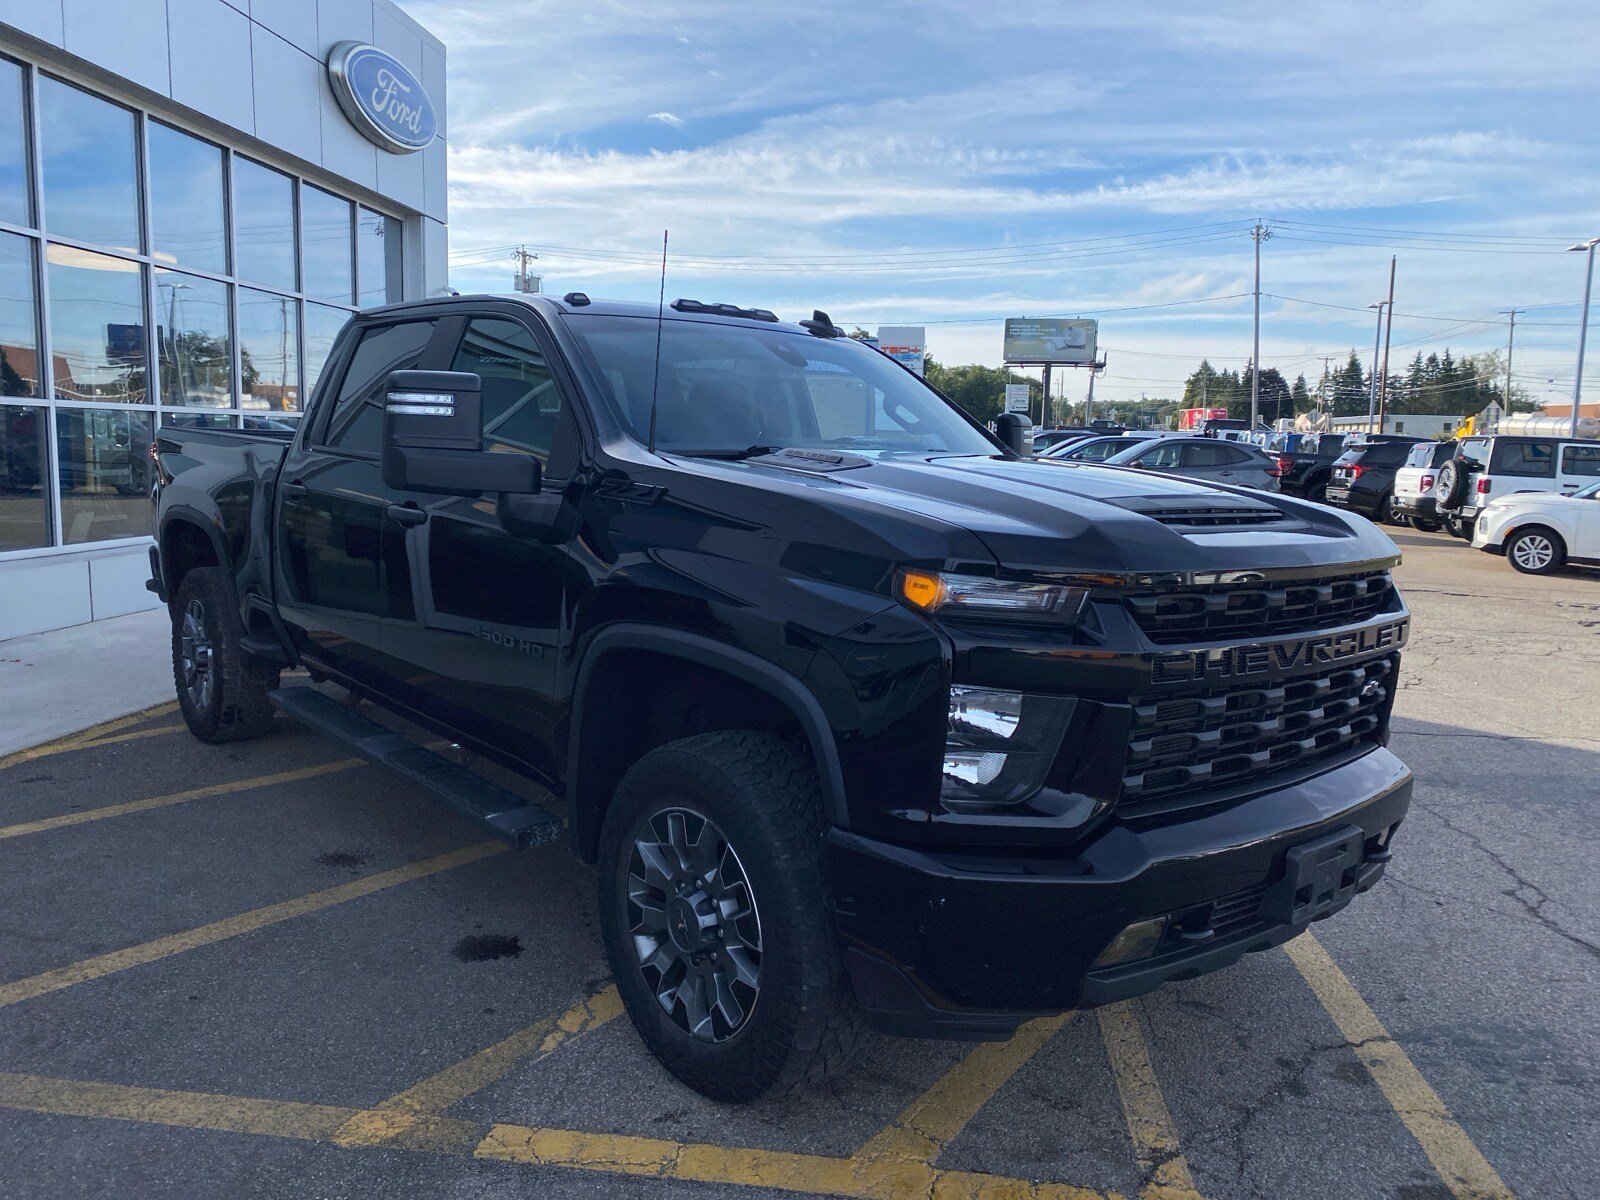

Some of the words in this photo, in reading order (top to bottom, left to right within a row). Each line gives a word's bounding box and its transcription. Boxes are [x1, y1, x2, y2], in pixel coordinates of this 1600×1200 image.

[371, 68, 422, 134] Ford
[519, 640, 545, 658] HD
[1150, 620, 1408, 685] CHEVROLET
